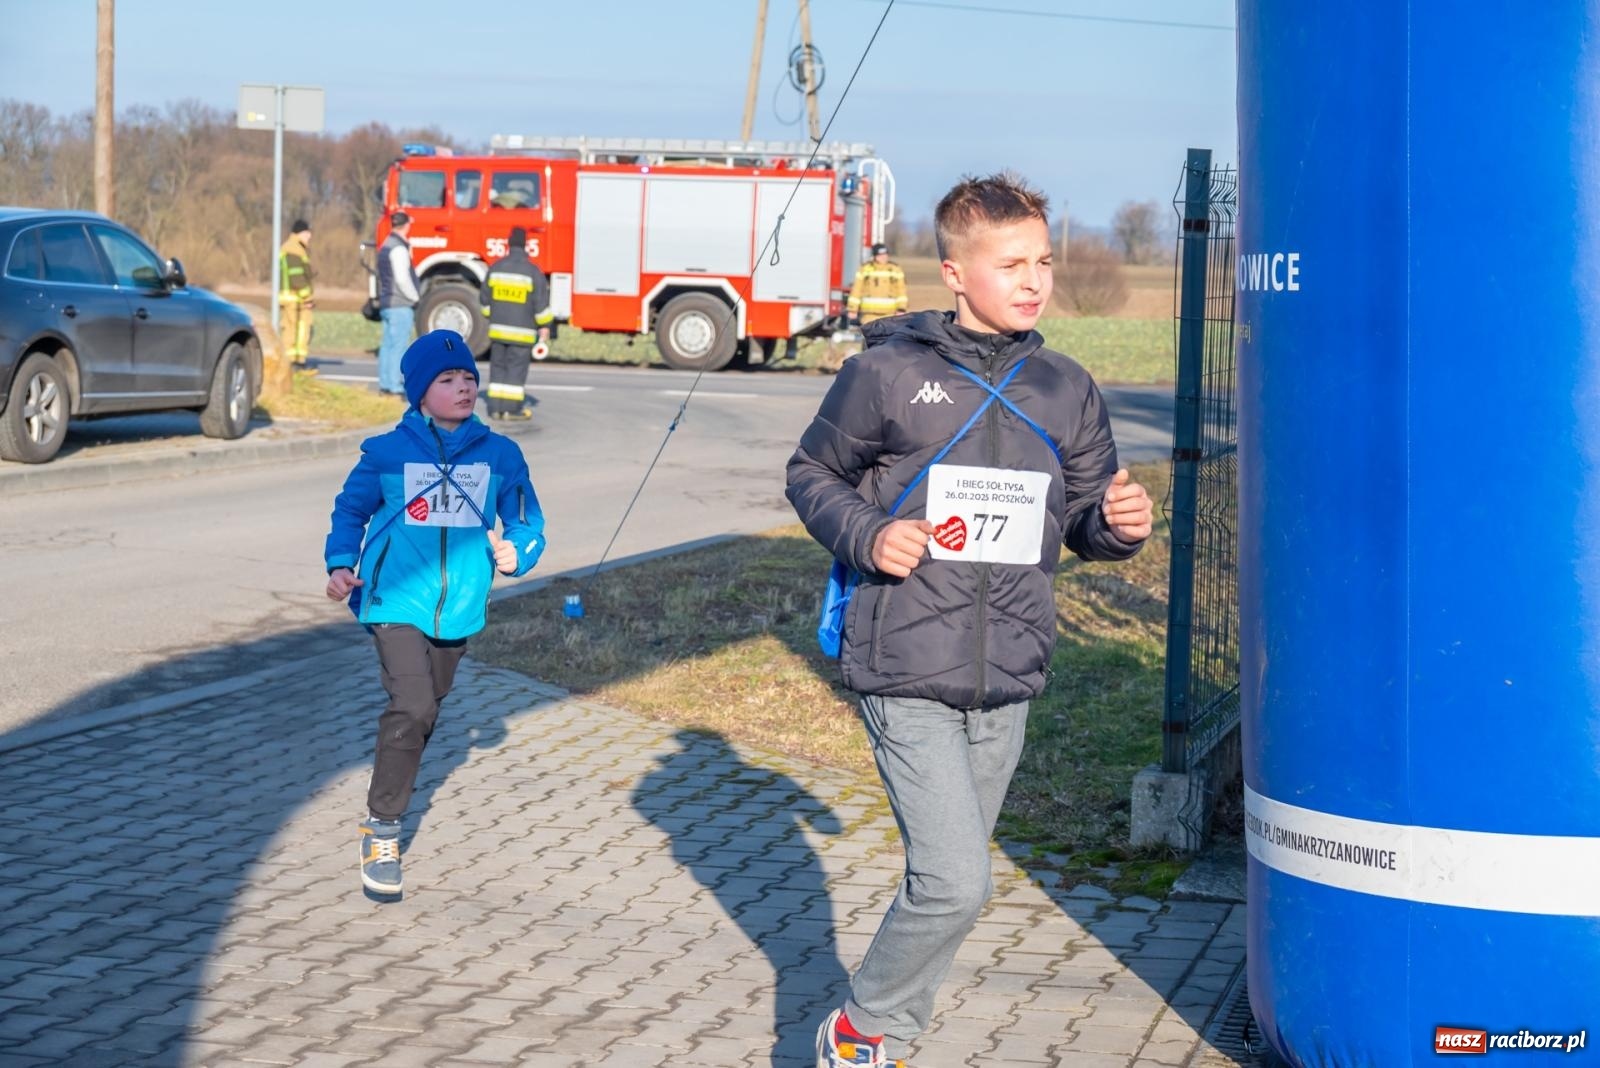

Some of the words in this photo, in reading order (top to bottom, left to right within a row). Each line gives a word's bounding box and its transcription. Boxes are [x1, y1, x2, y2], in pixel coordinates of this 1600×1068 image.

[956, 479, 960, 488] I
[962, 479, 985, 489] BIEG
[986, 481, 1024, 492] SOŁTYSA
[429, 493, 466, 514] 117
[945, 491, 989, 502] 26.01.2025
[991, 493, 1035, 504] ROSZKÓW
[973, 513, 1009, 542] 77
